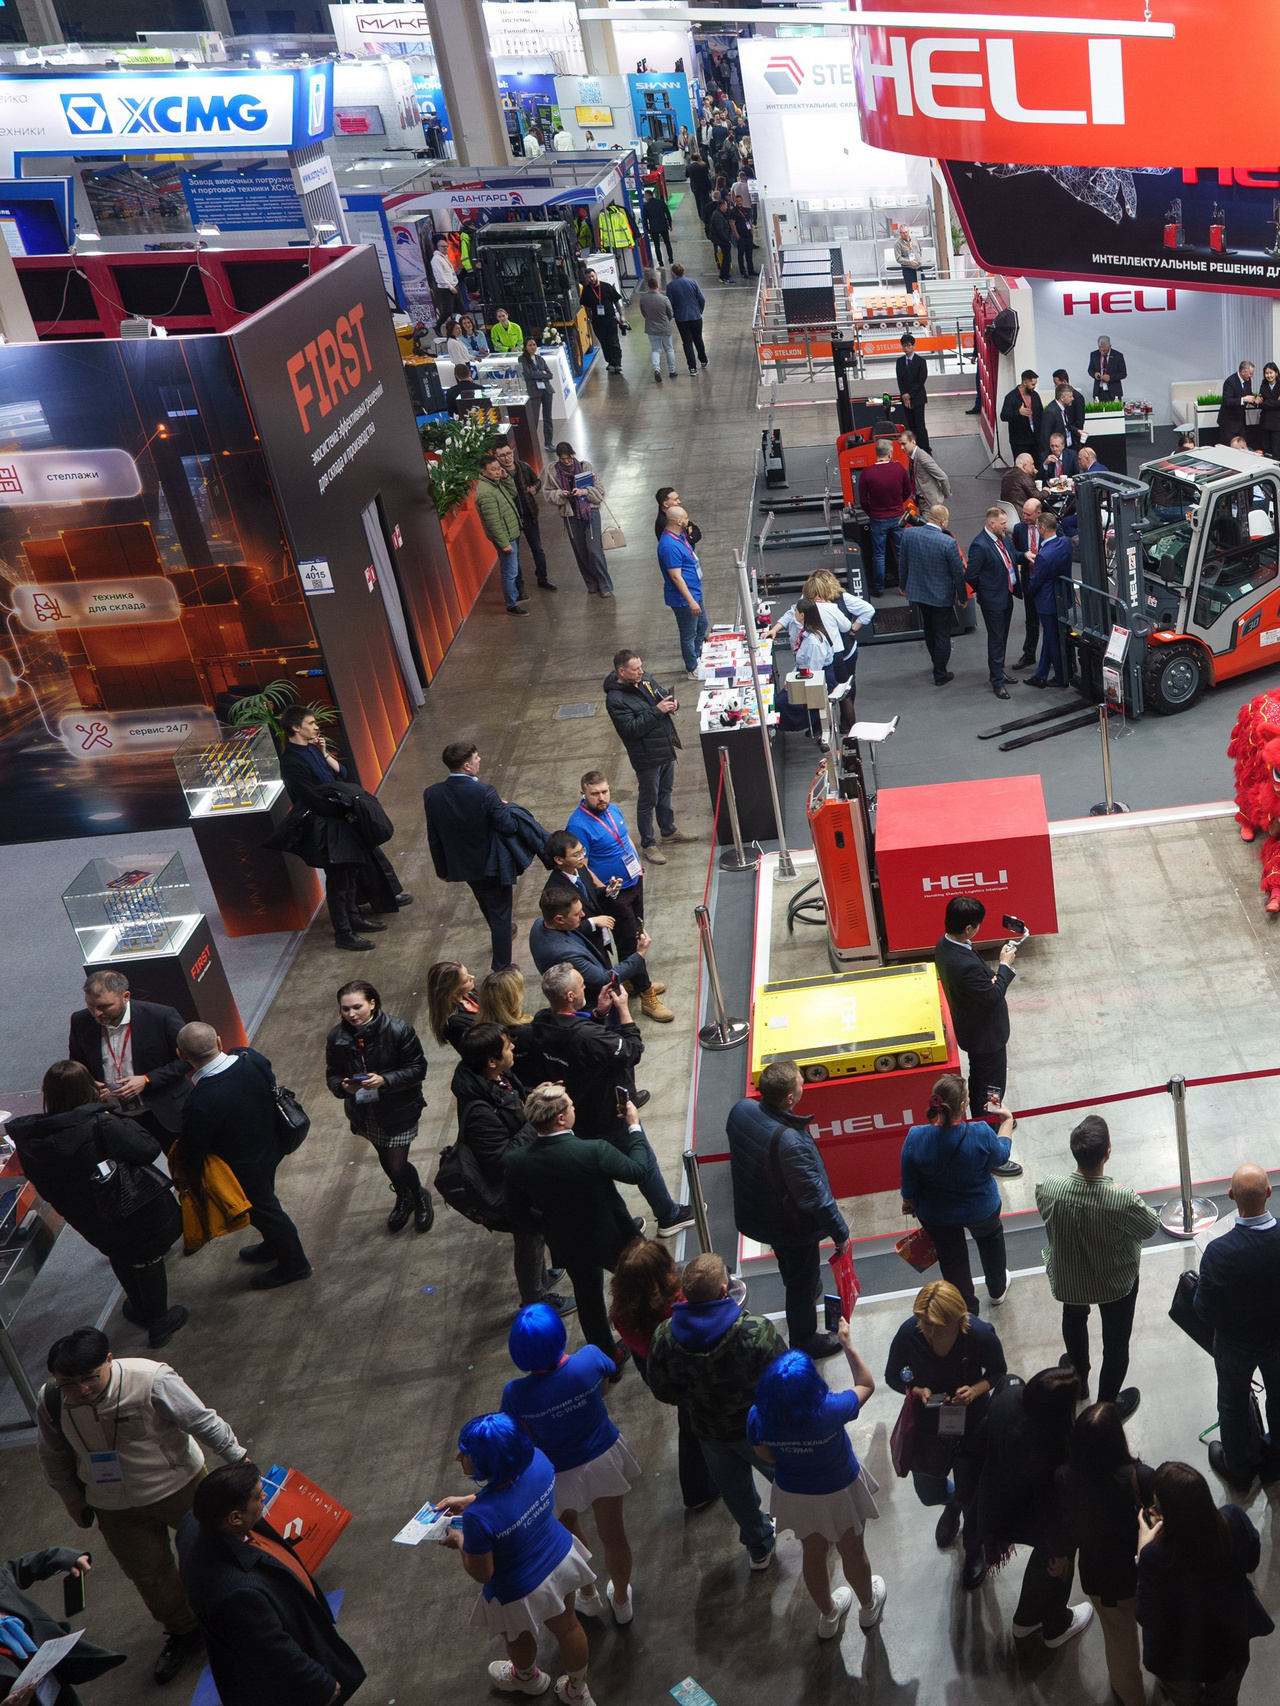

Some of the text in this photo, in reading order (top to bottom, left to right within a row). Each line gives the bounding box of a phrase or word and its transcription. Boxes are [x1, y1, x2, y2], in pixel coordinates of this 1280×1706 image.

[812, 64, 853, 85] STE
[860, 35, 1126, 125] HELI
[766, 102, 838, 110] ИНТЕЛЛЕКТУАЛЬНЫЕ
[118, 94, 268, 135] XCMG
[188, 178, 215, 187] Завод
[215, 177, 253, 186] вилочных
[198, 186, 237, 195] портовой
[450, 193, 508, 204] АВАНГАРД
[1092, 253, 1208, 272] ИНТЕЛЛЕКТУАЛЬНЫЕ
[1209, 262, 1264, 276] РЕШЕНИЯ
[1063, 288, 1177, 316] HELI
[774, 349, 803, 358] STELKON
[286, 302, 373, 435] FIRST
[47, 471, 100, 481] стеллажи
[305, 571, 326, 581] 4015
[851, 568, 863, 599] HELI
[1129, 569, 1139, 608] HELI
[92, 592, 134, 602] техника
[88, 601, 147, 614] для склада
[1247, 618, 1260, 632] 30
[129, 723, 189, 738] сервис 24/7
[922, 869, 1009, 893] HELI
[808, 1109, 914, 1140] HELI
